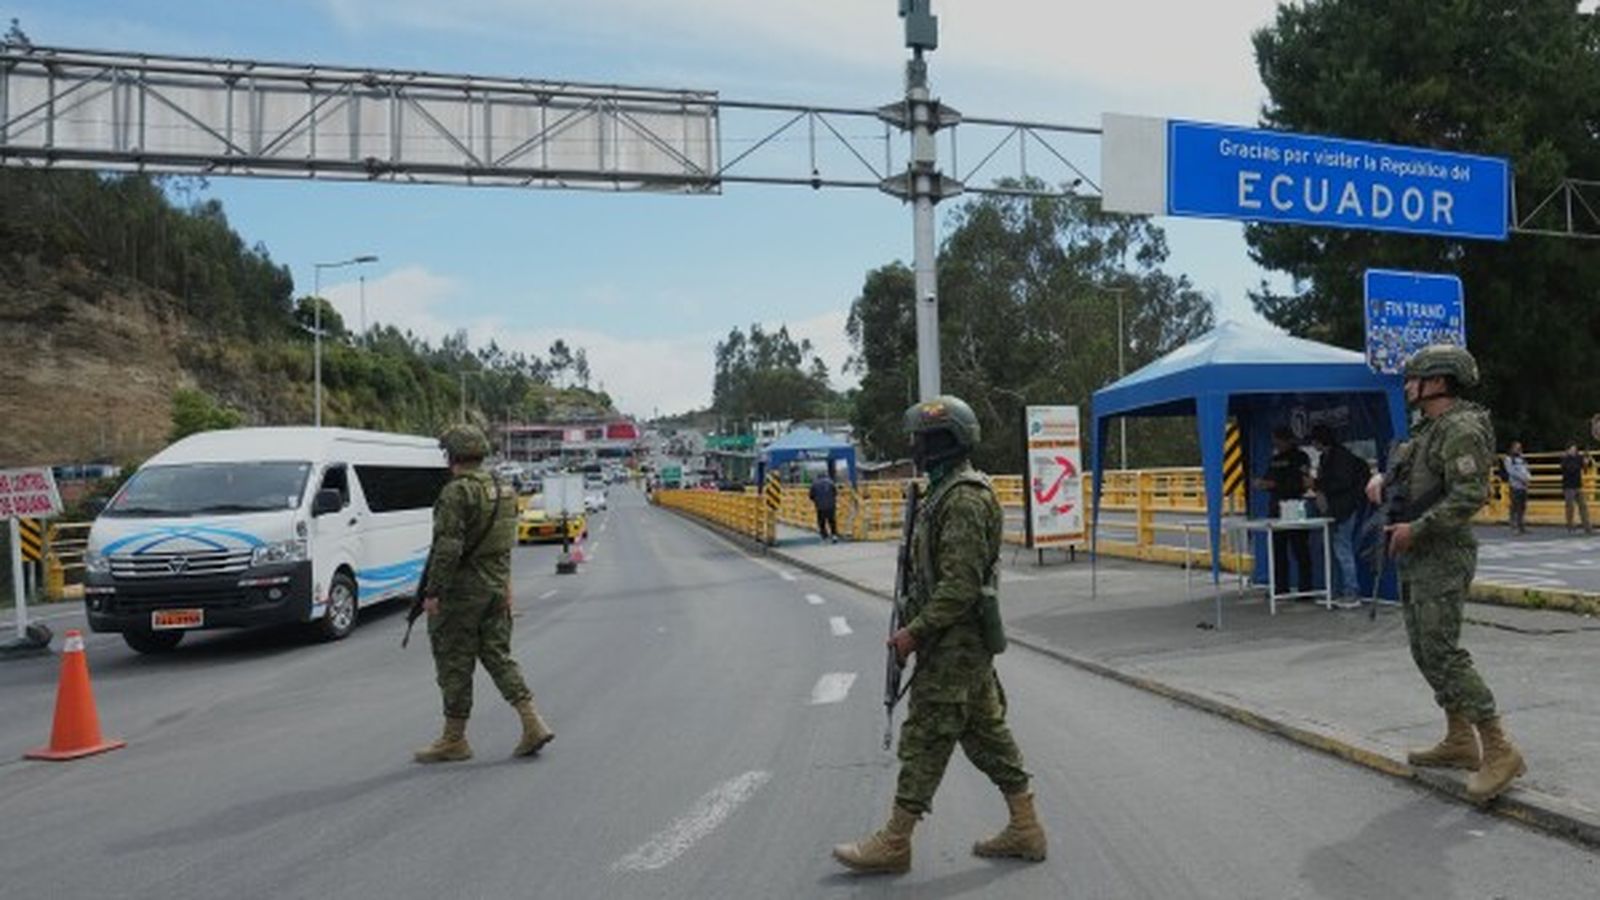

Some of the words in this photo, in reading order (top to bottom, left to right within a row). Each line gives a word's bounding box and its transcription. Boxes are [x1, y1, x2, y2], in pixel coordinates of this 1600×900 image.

[1219, 138, 1279, 161] Gracias
[1283, 148, 1308, 166] por
[1313, 149, 1360, 169] visitar
[1364, 155, 1377, 172] la
[1450, 166, 1471, 182] del
[1238, 170, 1455, 224] ECUADOR
[1384, 300, 1404, 316] FIN
[1405, 302, 1447, 319] TRAMO
